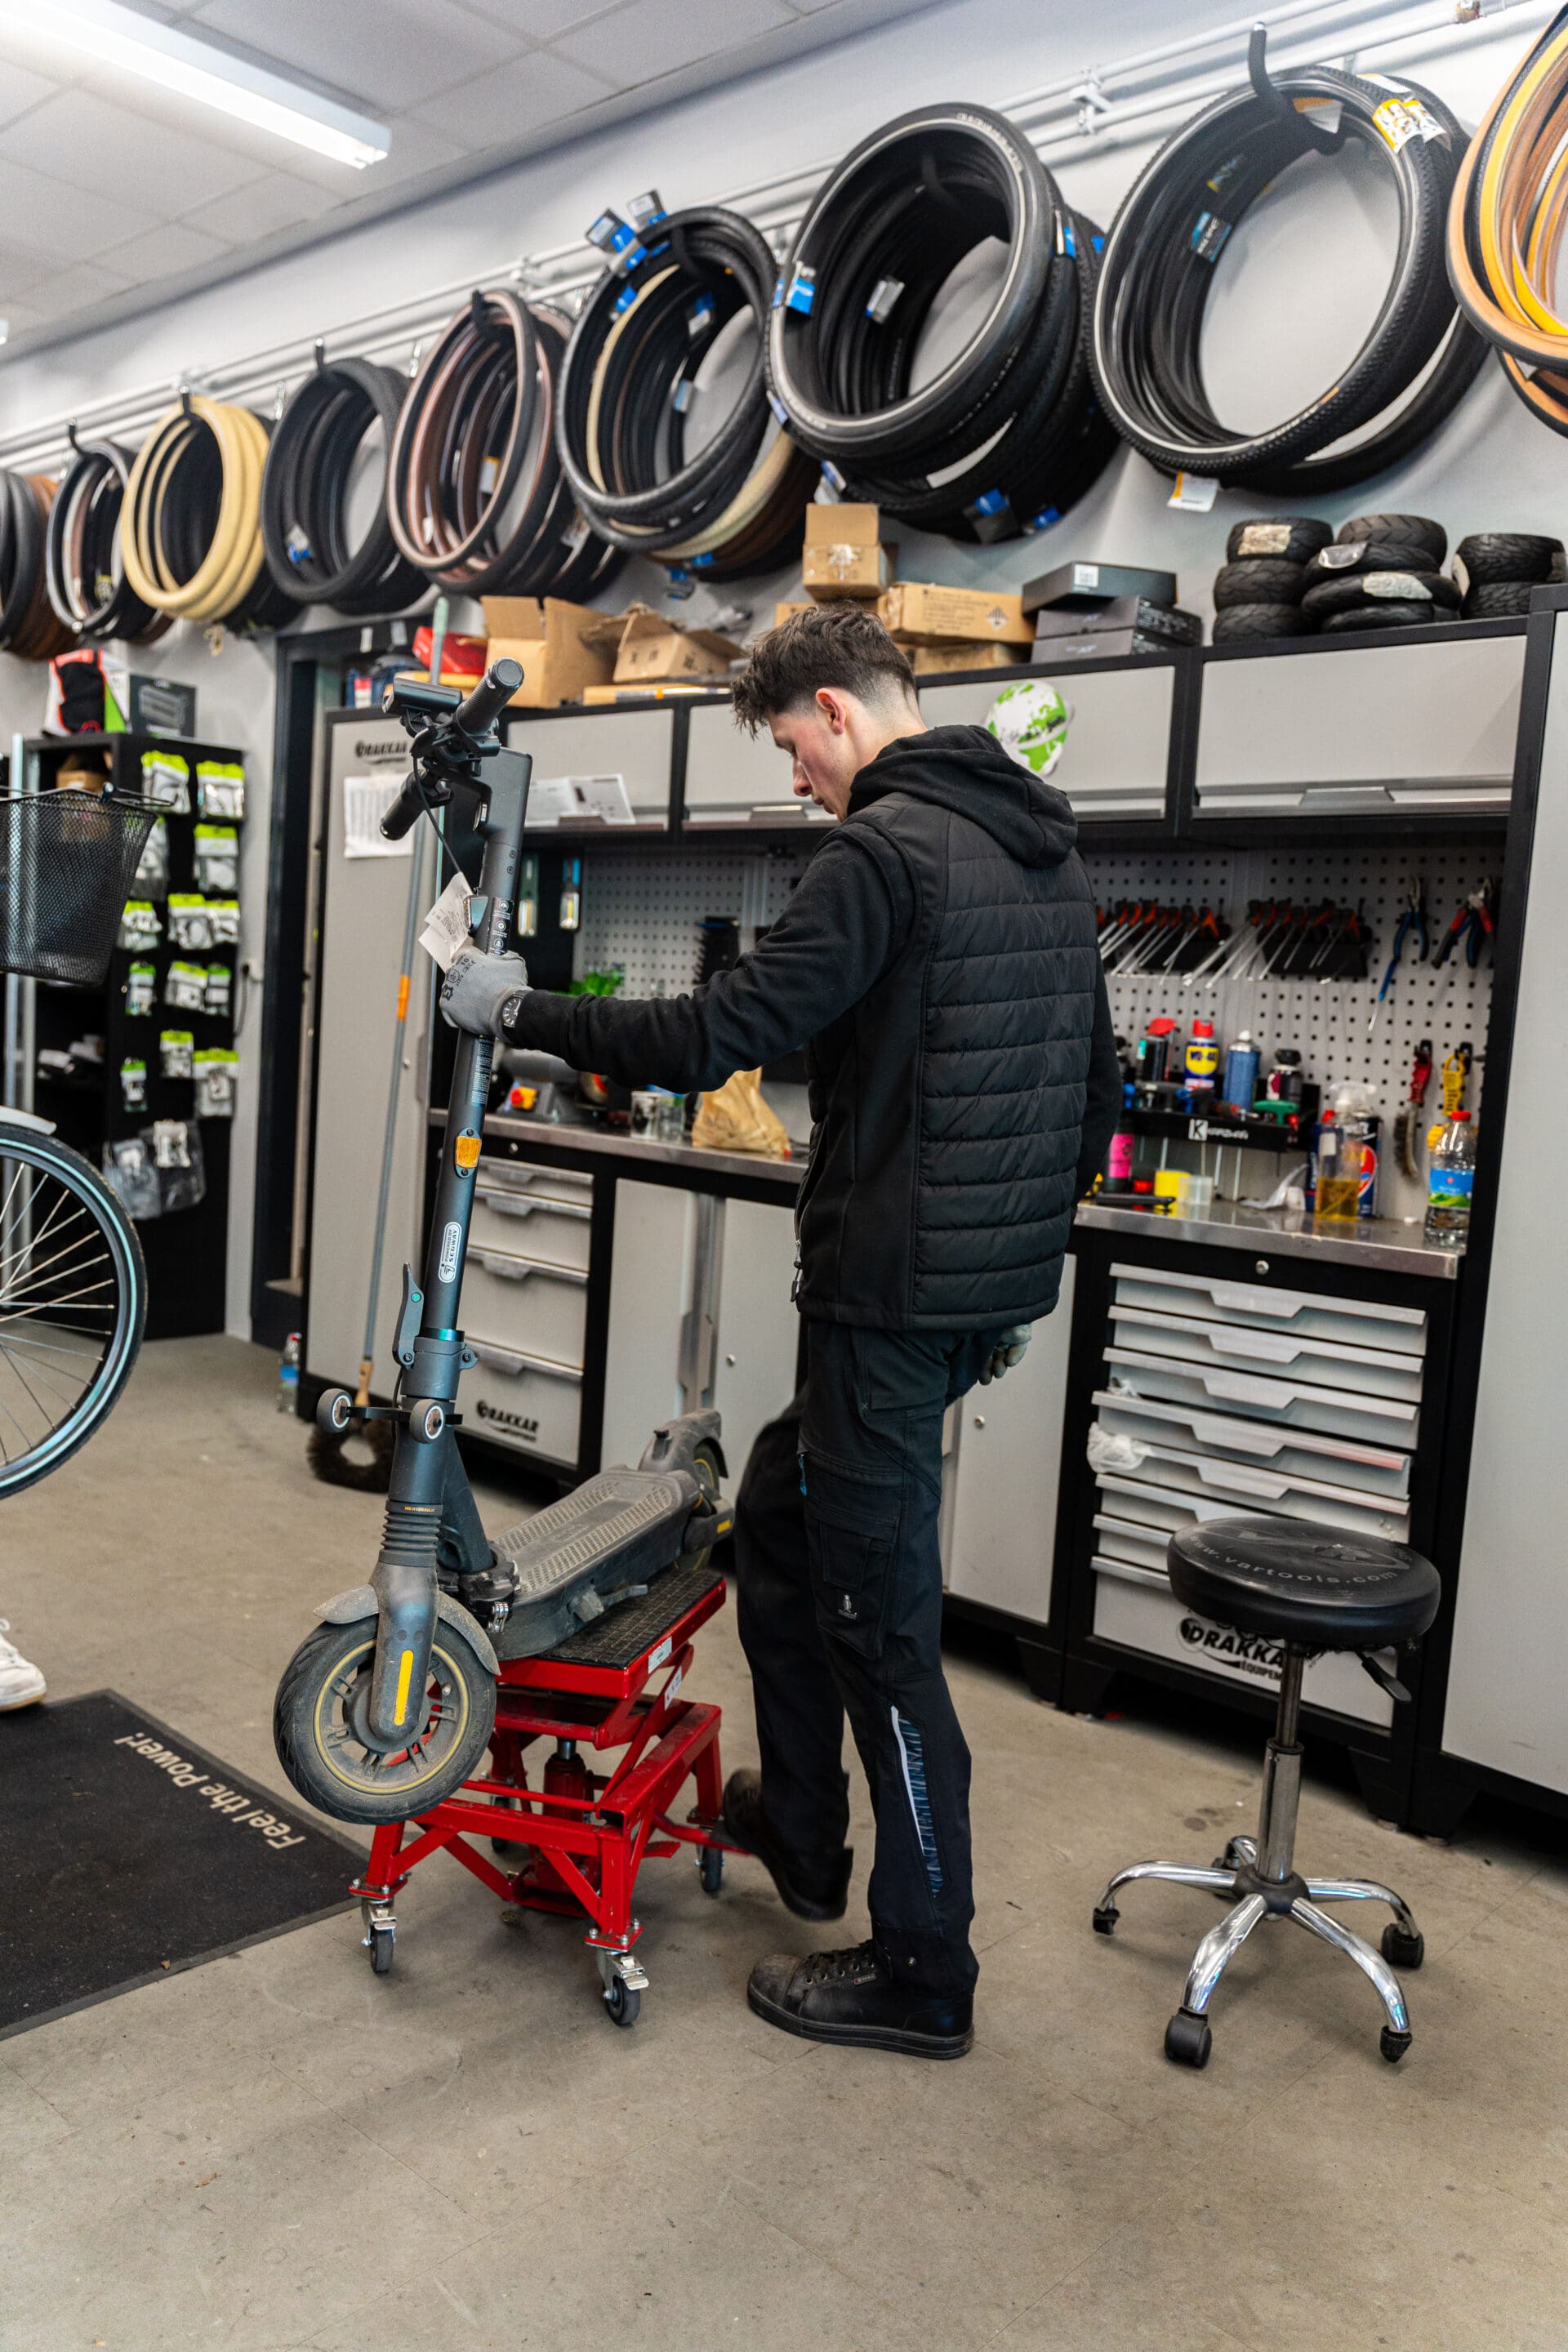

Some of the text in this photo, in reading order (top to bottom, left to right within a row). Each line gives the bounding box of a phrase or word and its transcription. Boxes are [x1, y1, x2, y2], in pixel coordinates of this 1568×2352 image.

[449, 1229, 457, 1263] SEGWAY
[1189, 1534, 1398, 1584] www.vartools.com
[1181, 1619, 1283, 1668] DRAKKA
[114, 1732, 306, 1850] Feel the Power!
